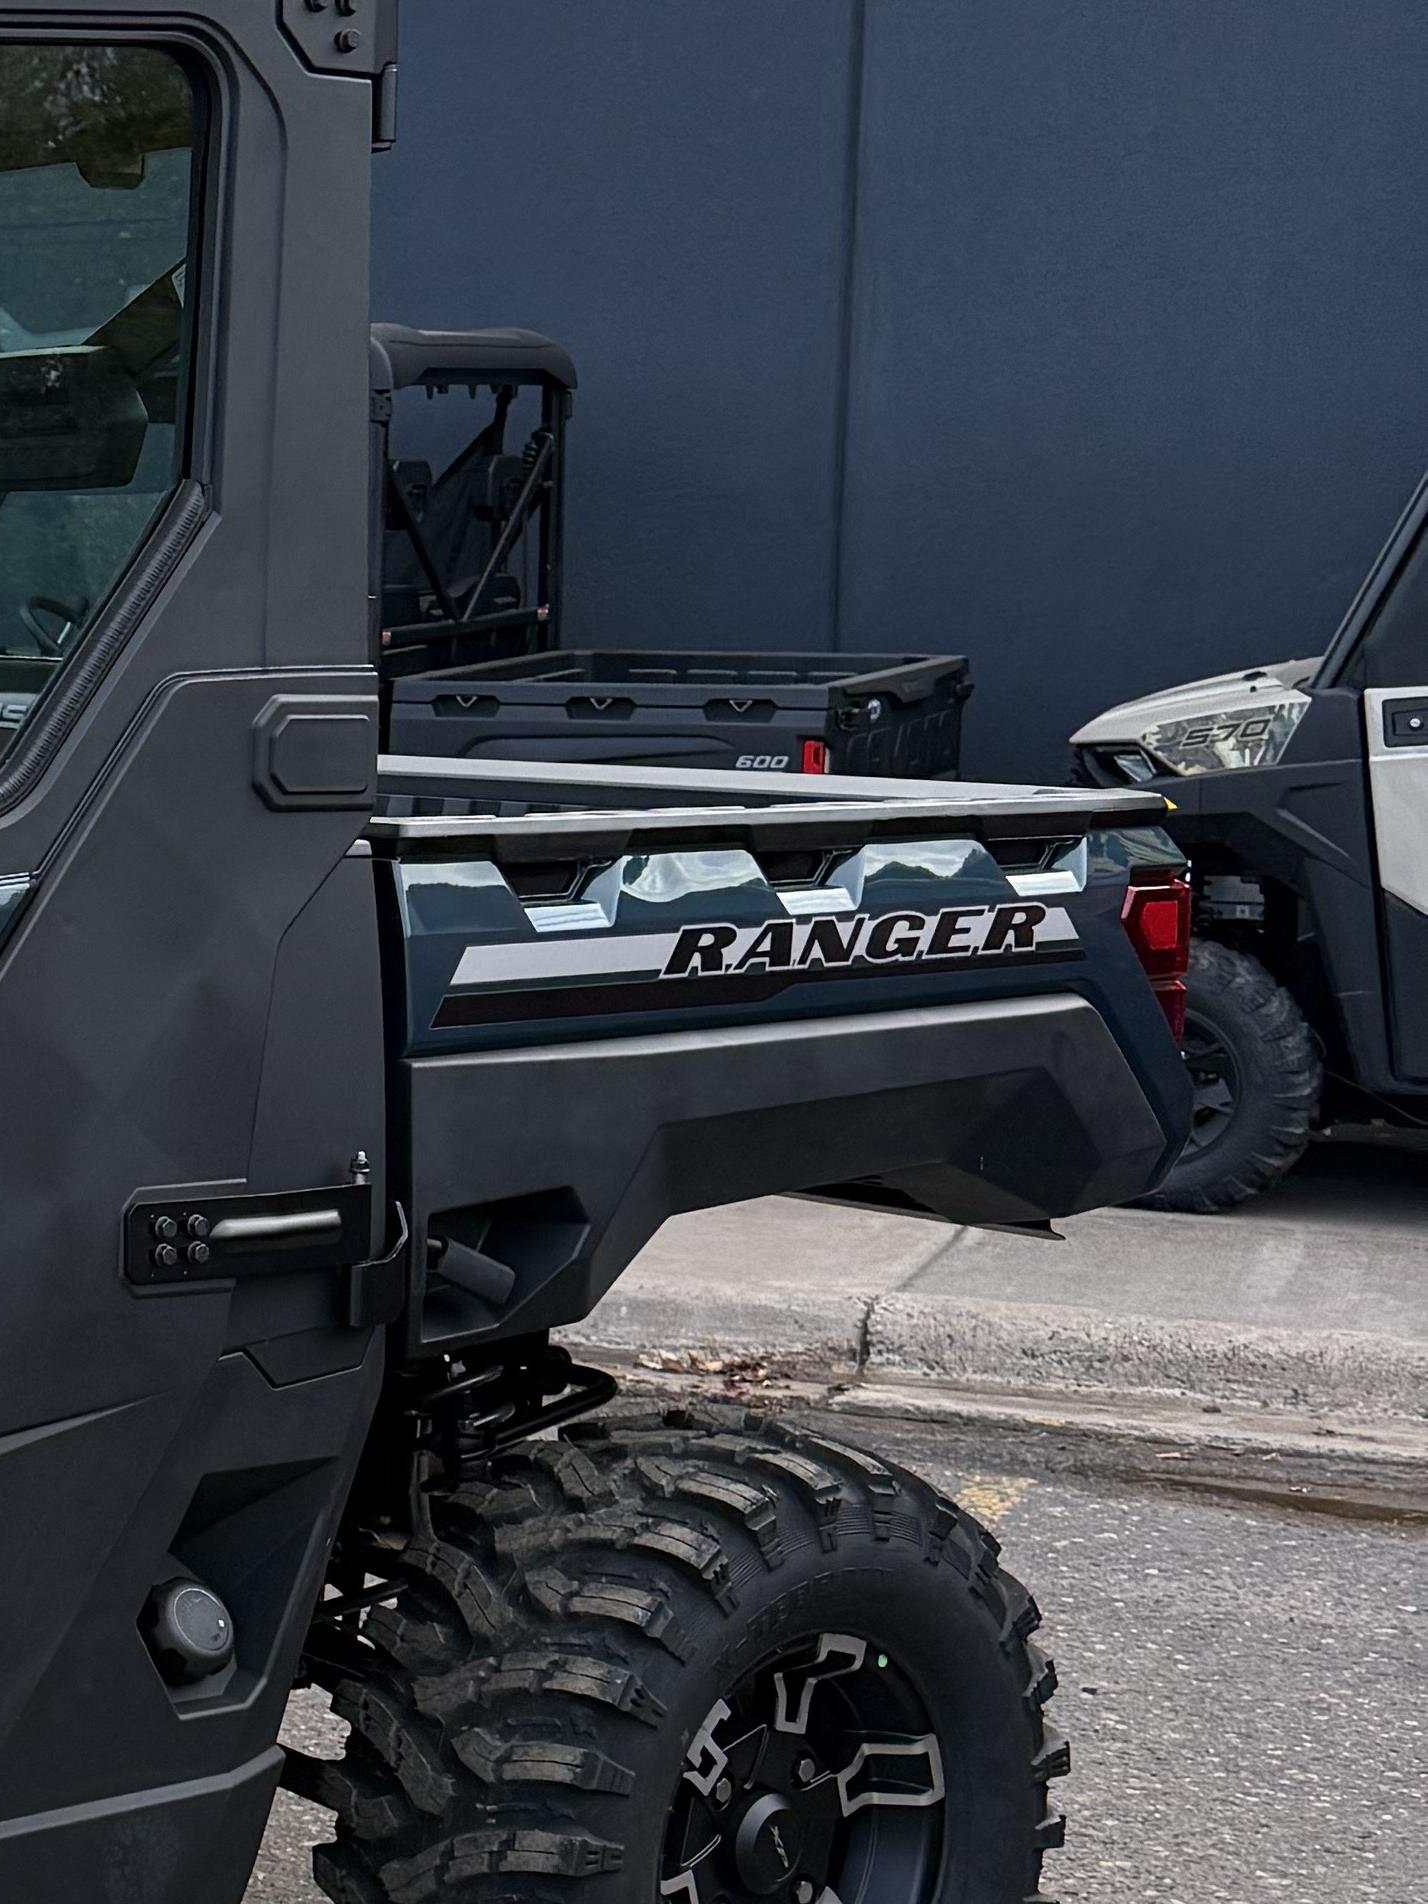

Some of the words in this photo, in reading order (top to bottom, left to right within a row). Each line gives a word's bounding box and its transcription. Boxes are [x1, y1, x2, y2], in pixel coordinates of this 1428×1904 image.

[1179, 718, 1272, 748] 570
[736, 755, 790, 769] 600
[660, 901, 1048, 980] RANGER
